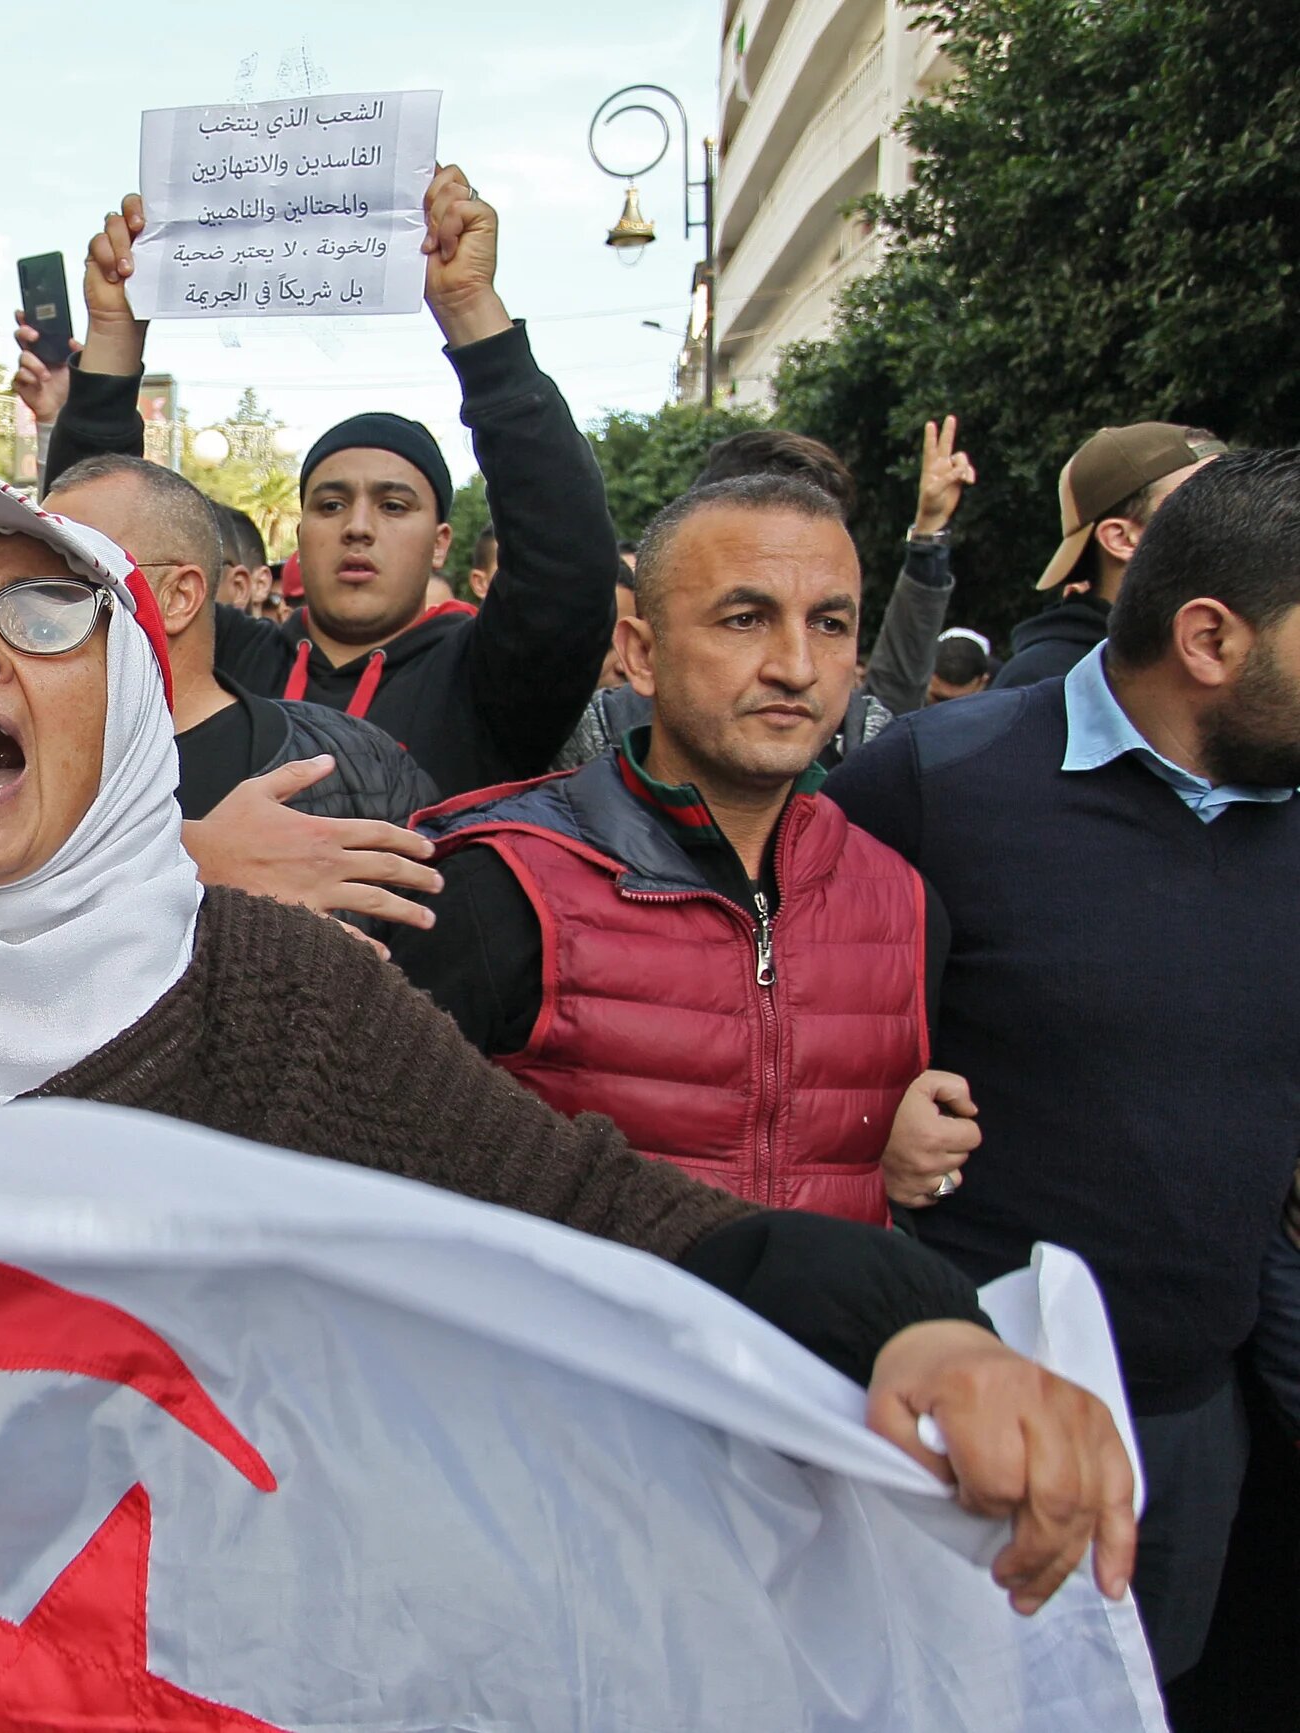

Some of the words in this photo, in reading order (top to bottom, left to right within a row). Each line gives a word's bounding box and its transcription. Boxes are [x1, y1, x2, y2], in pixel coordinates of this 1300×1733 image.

[199, 116, 259, 140] ينتخب
[266, 106, 309, 139] الذي
[315, 100, 384, 131] الشعب
[192, 153, 289, 184] والانتهازيين
[295, 145, 382, 176] الفاسدين
[198, 198, 276, 227] والناهبين
[283, 193, 369, 223] والمحتالين
[172, 244, 225, 267] ضحية
[230, 249, 275, 265] يعتبر
[281, 240, 298, 258] لا
[316, 237, 387, 260] والخونة
[185, 281, 248, 310] الجريمة
[255, 279, 272, 310] في
[340, 278, 364, 305] بل
